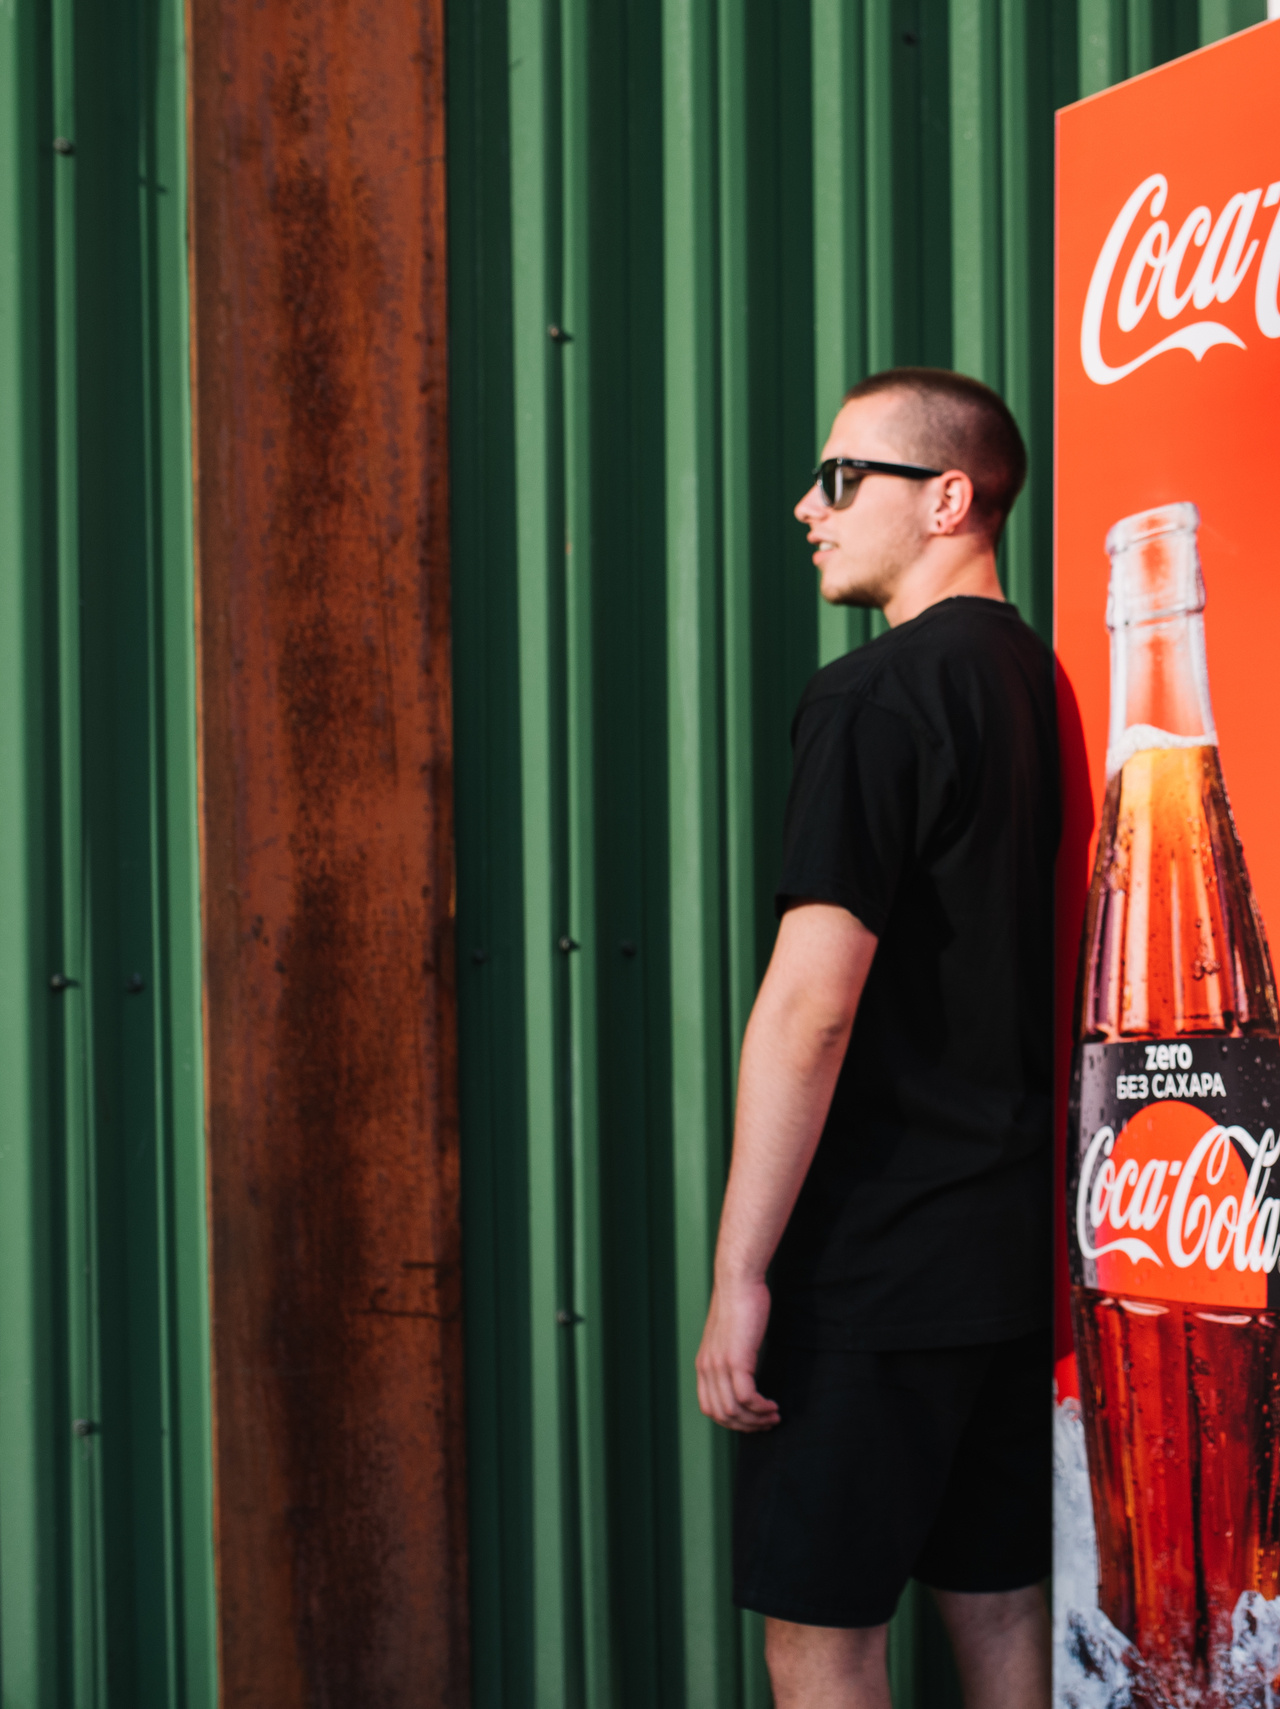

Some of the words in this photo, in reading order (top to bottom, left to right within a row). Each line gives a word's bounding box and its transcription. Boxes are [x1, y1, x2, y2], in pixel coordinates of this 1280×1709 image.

[1145, 1043, 1193, 1071] zero
[1116, 1074, 1149, 1100] БЕЗ
[1151, 1072, 1227, 1099] САХАРА
